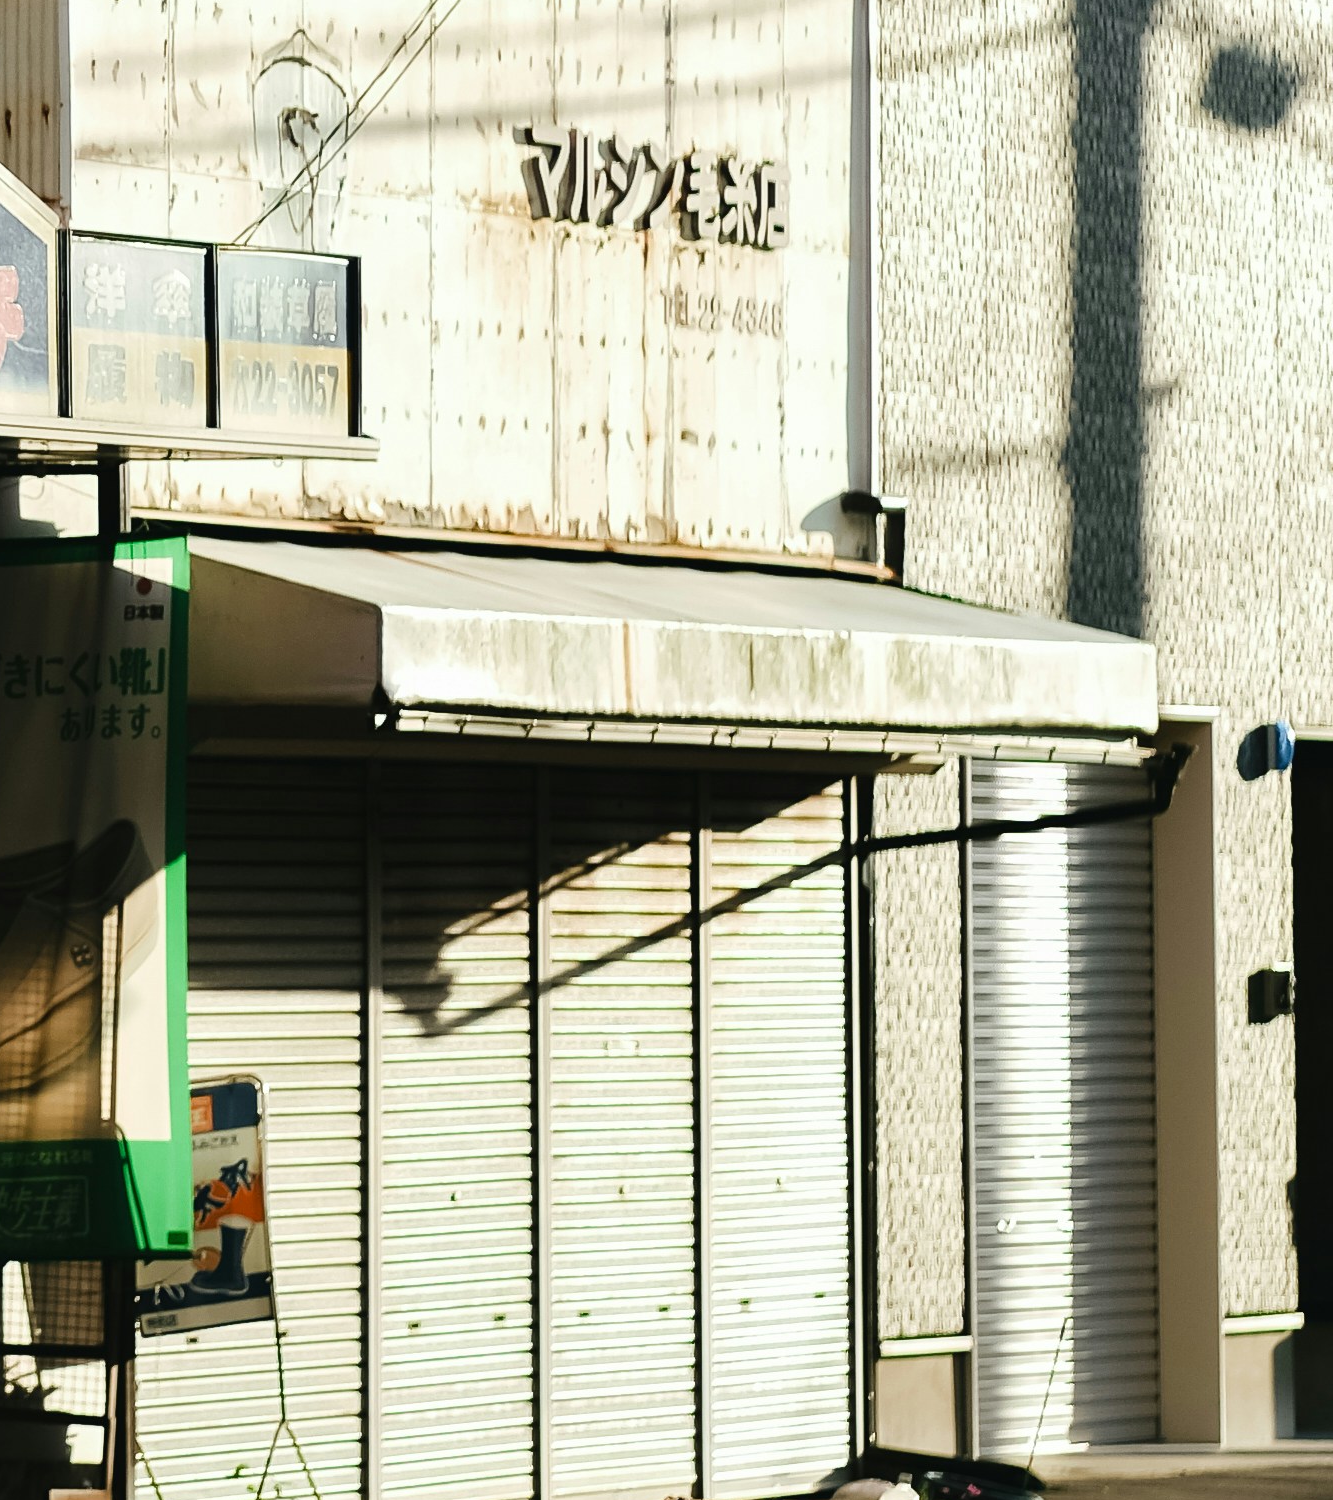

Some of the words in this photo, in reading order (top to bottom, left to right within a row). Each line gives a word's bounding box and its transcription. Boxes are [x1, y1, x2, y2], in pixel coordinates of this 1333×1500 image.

[123, 604, 165, 621] 日本製
[59, 703, 161, 742] あります。
